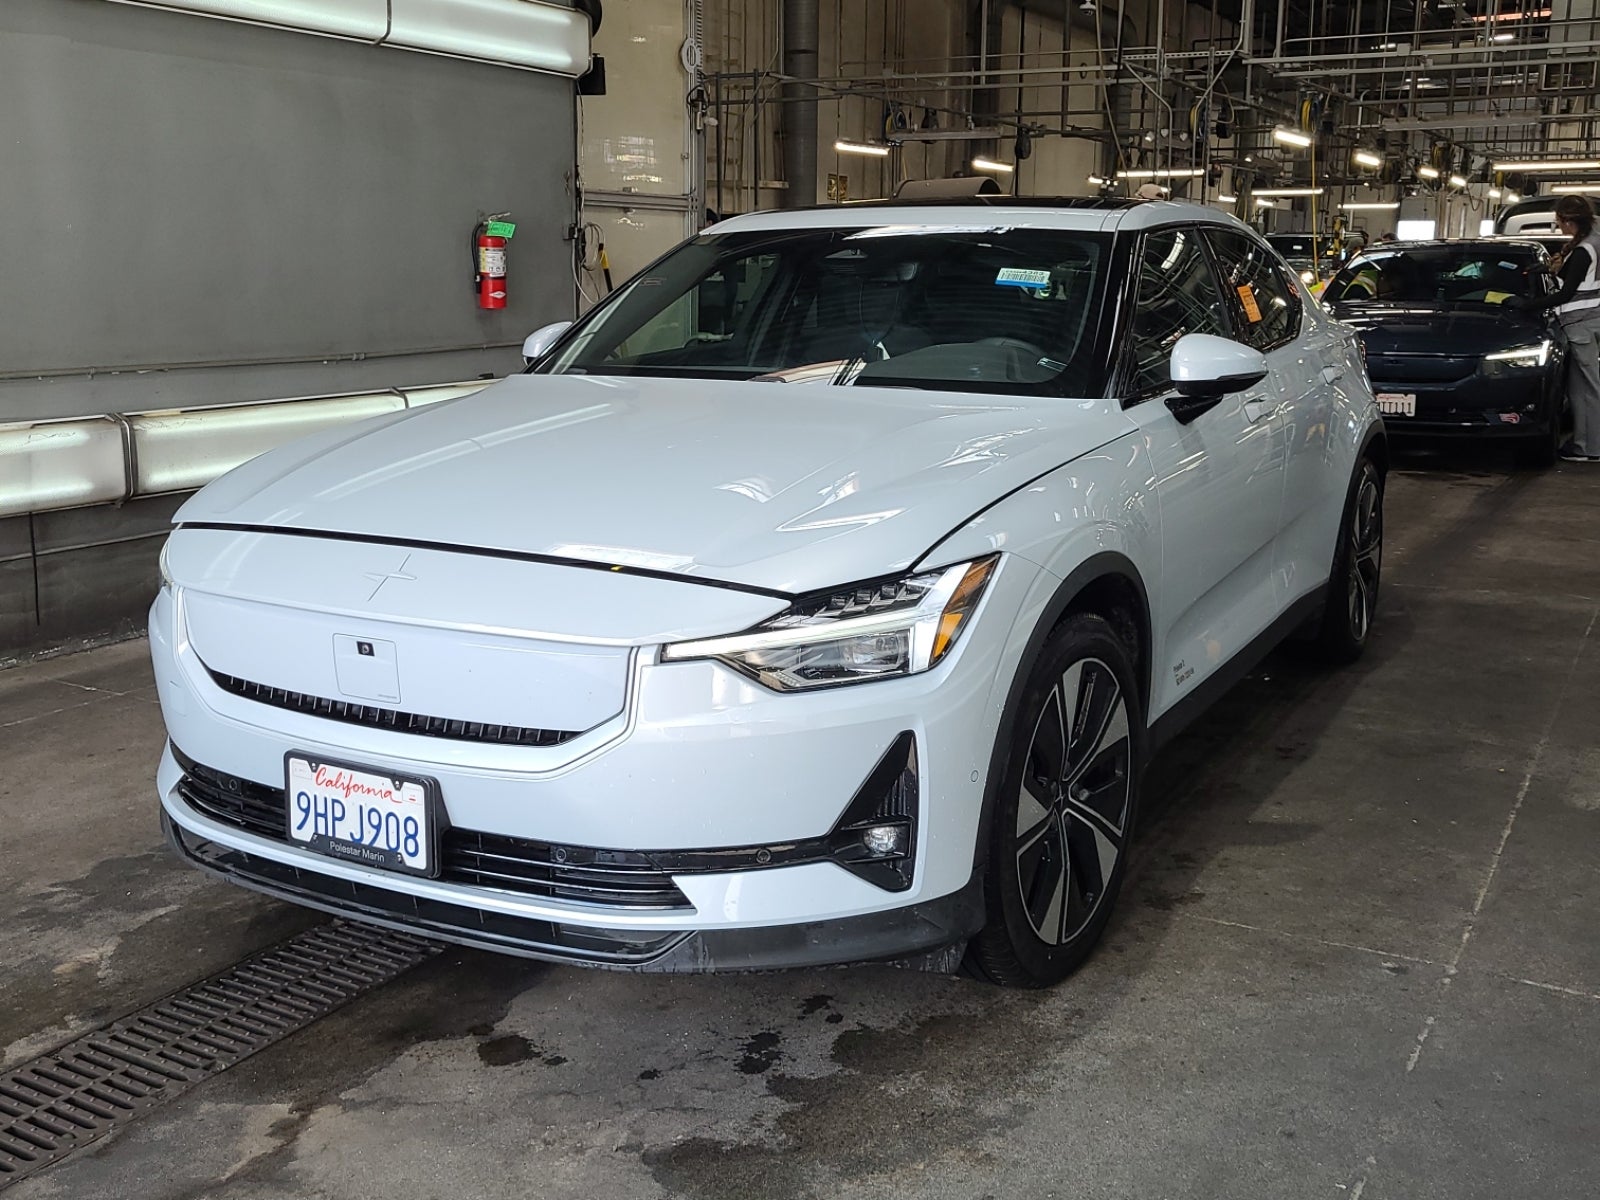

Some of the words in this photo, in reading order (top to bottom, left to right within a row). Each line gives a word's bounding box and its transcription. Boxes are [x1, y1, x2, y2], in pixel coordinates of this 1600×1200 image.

[315, 766, 402, 804] California
[296, 791, 419, 858] 9HPJ908
[329, 840, 361, 857] Polestar
[362, 848, 385, 863] Marin
